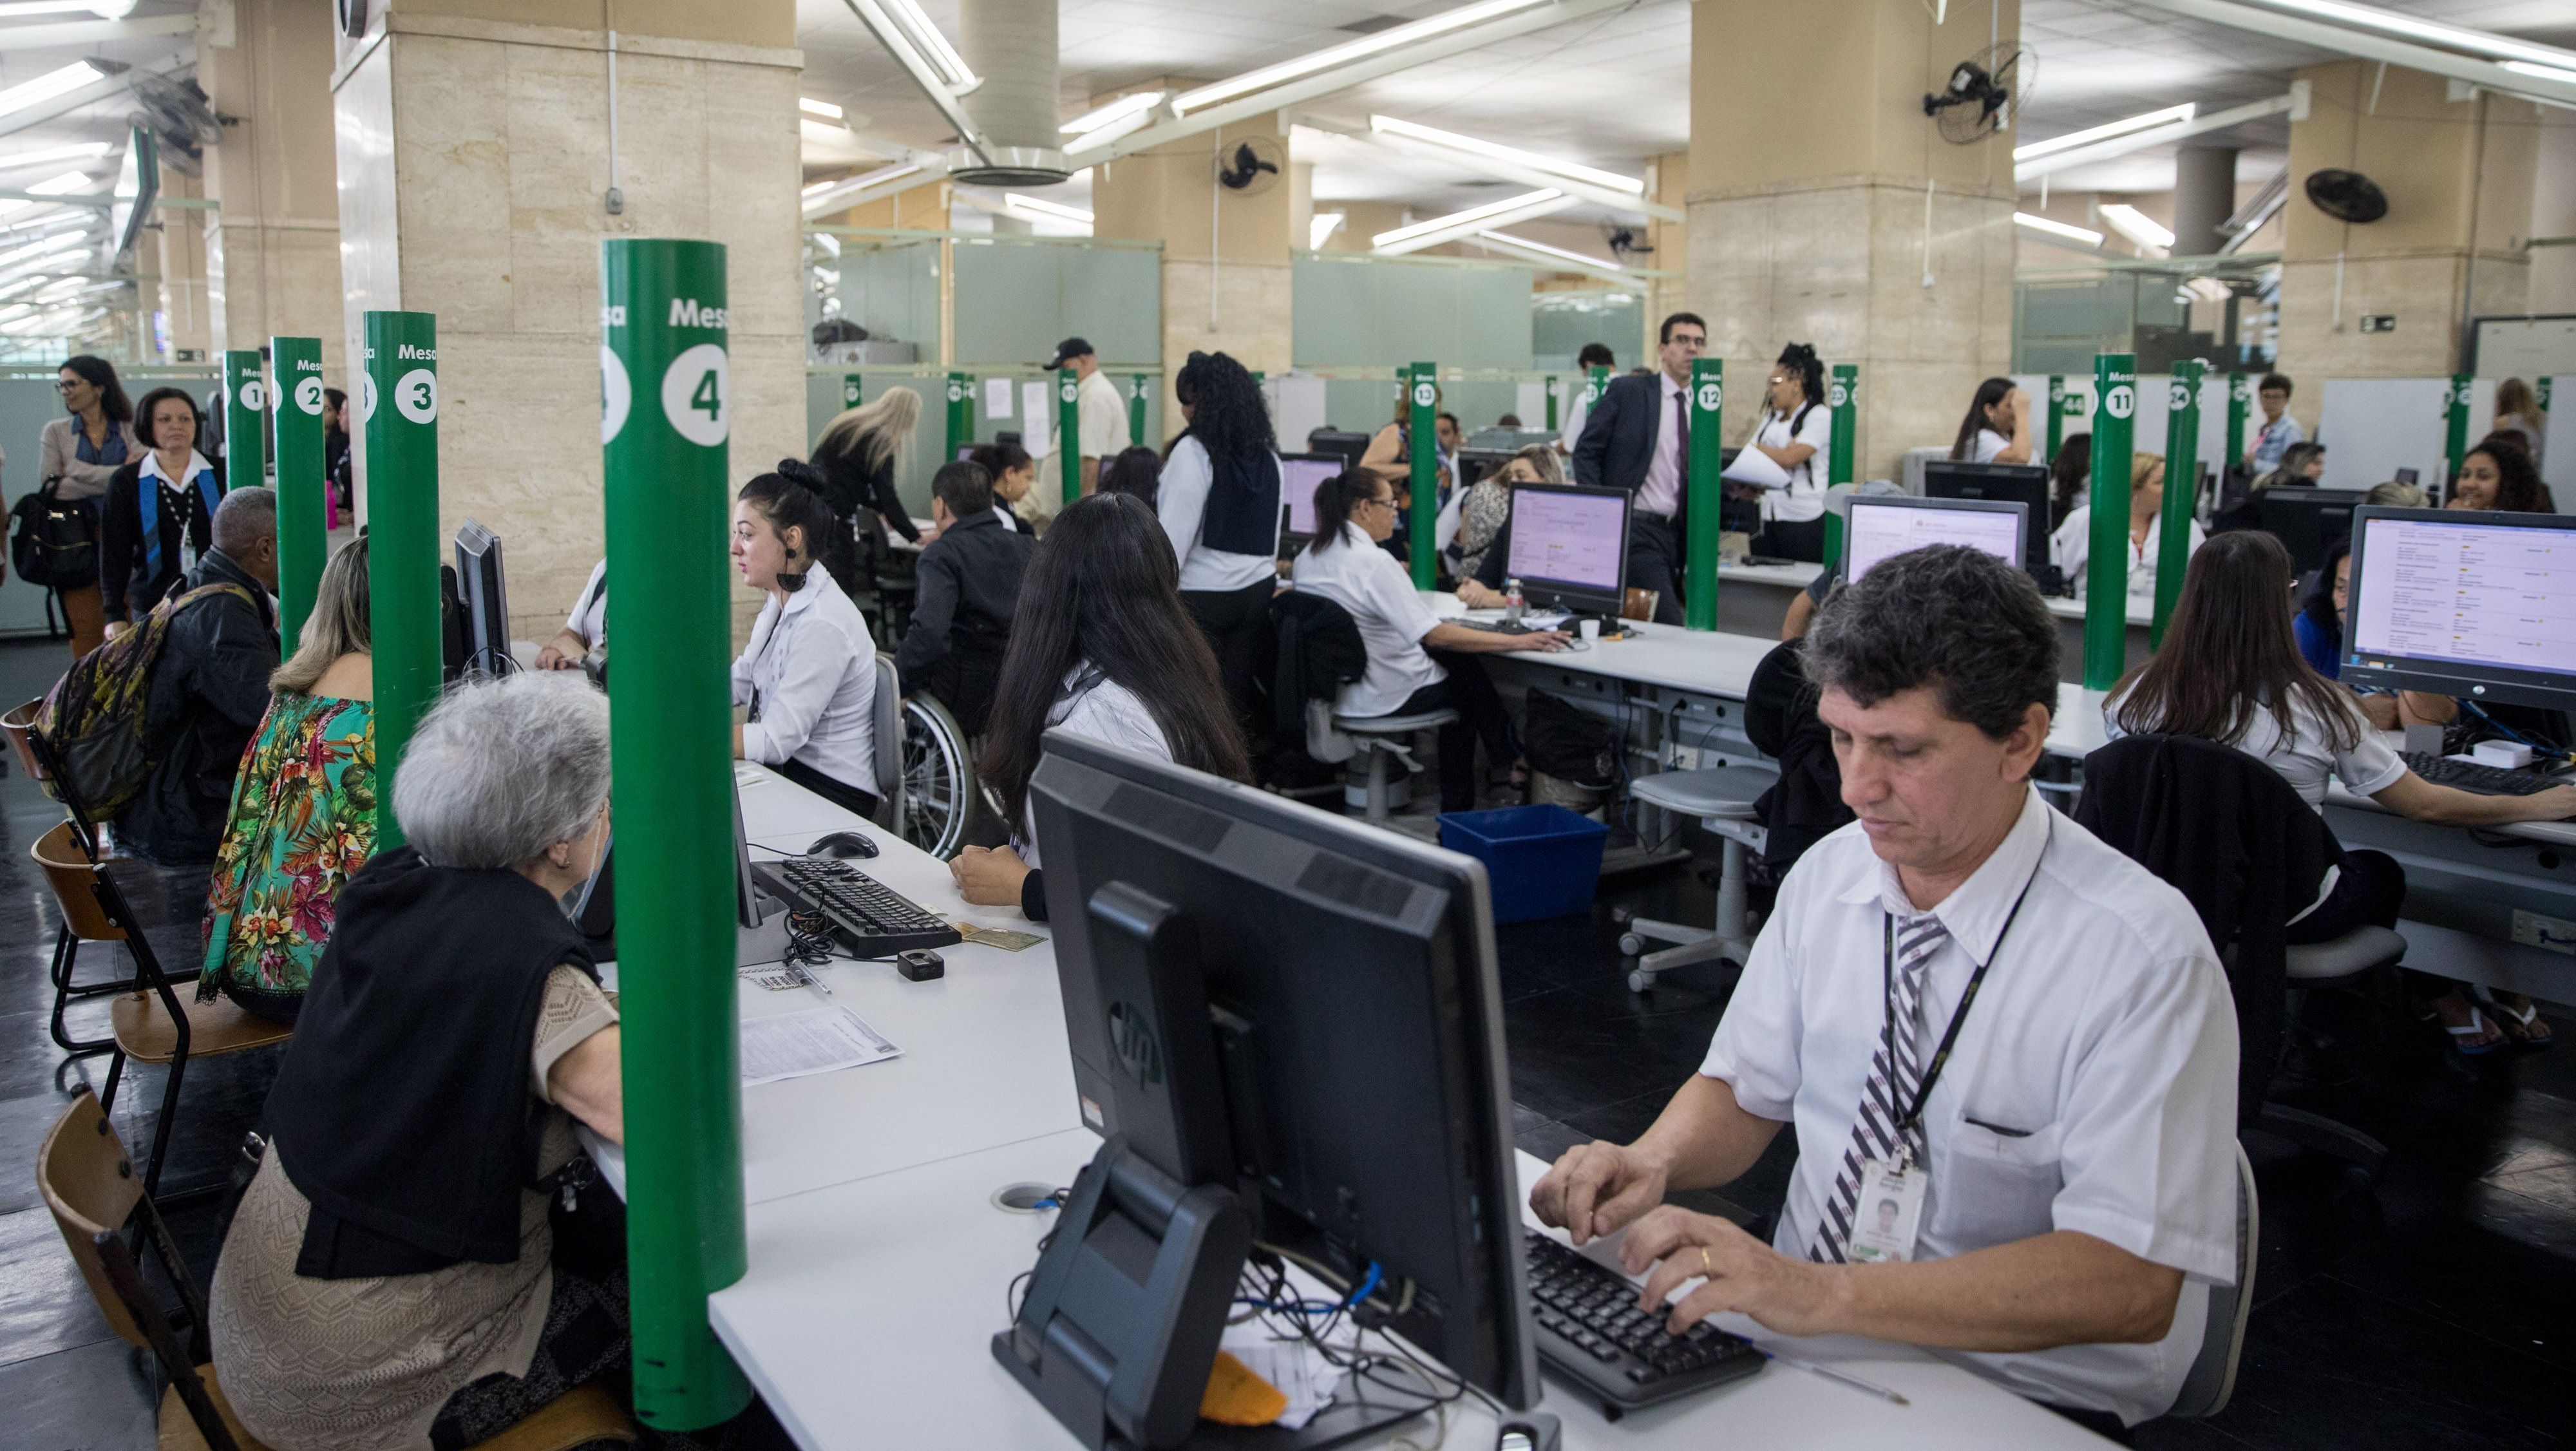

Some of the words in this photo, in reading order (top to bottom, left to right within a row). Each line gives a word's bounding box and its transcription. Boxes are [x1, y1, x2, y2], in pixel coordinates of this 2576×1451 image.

[668, 298, 728, 328] Mes
[1700, 372, 1721, 382] Mesa
[252, 389, 259, 403] 1
[308, 386, 320, 405] 2
[413, 383, 432, 410] 3
[690, 368, 721, 422] 4
[1419, 389, 1432, 400] 13
[1703, 391, 1719, 403] 12
[2114, 395, 2130, 410] 11
